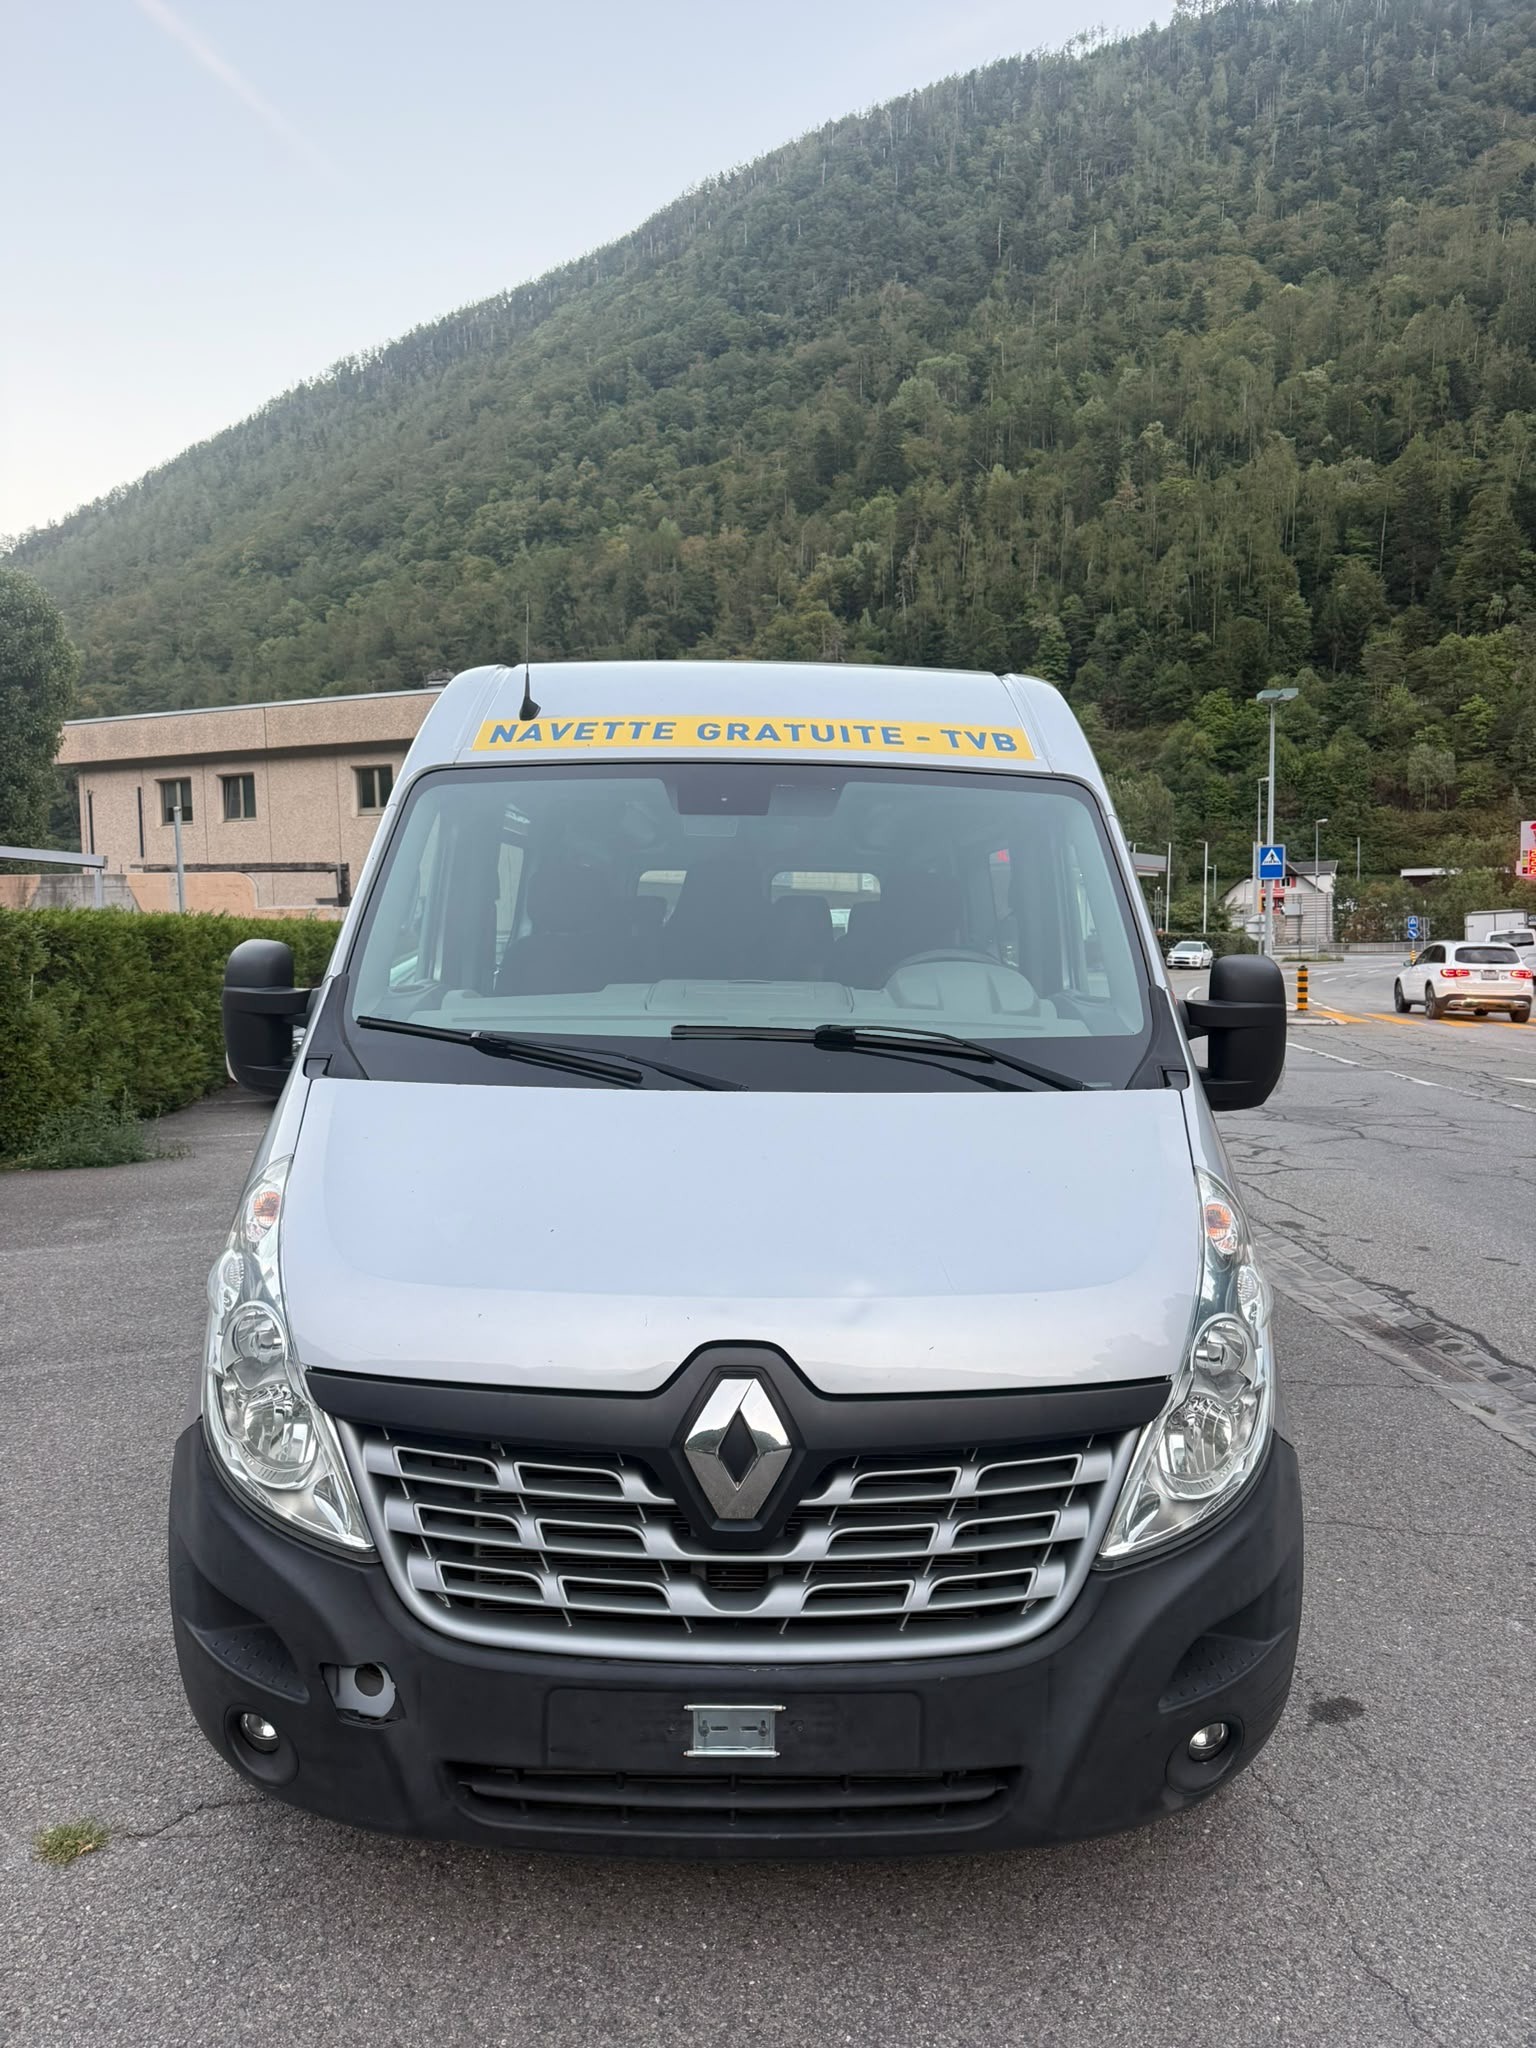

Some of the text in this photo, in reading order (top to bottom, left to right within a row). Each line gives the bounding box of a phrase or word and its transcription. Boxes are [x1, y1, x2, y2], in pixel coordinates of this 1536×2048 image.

[489, 721, 677, 744] NAVETTE
[696, 722, 905, 746] GRATUITE
[939, 729, 1018, 752] TVB
